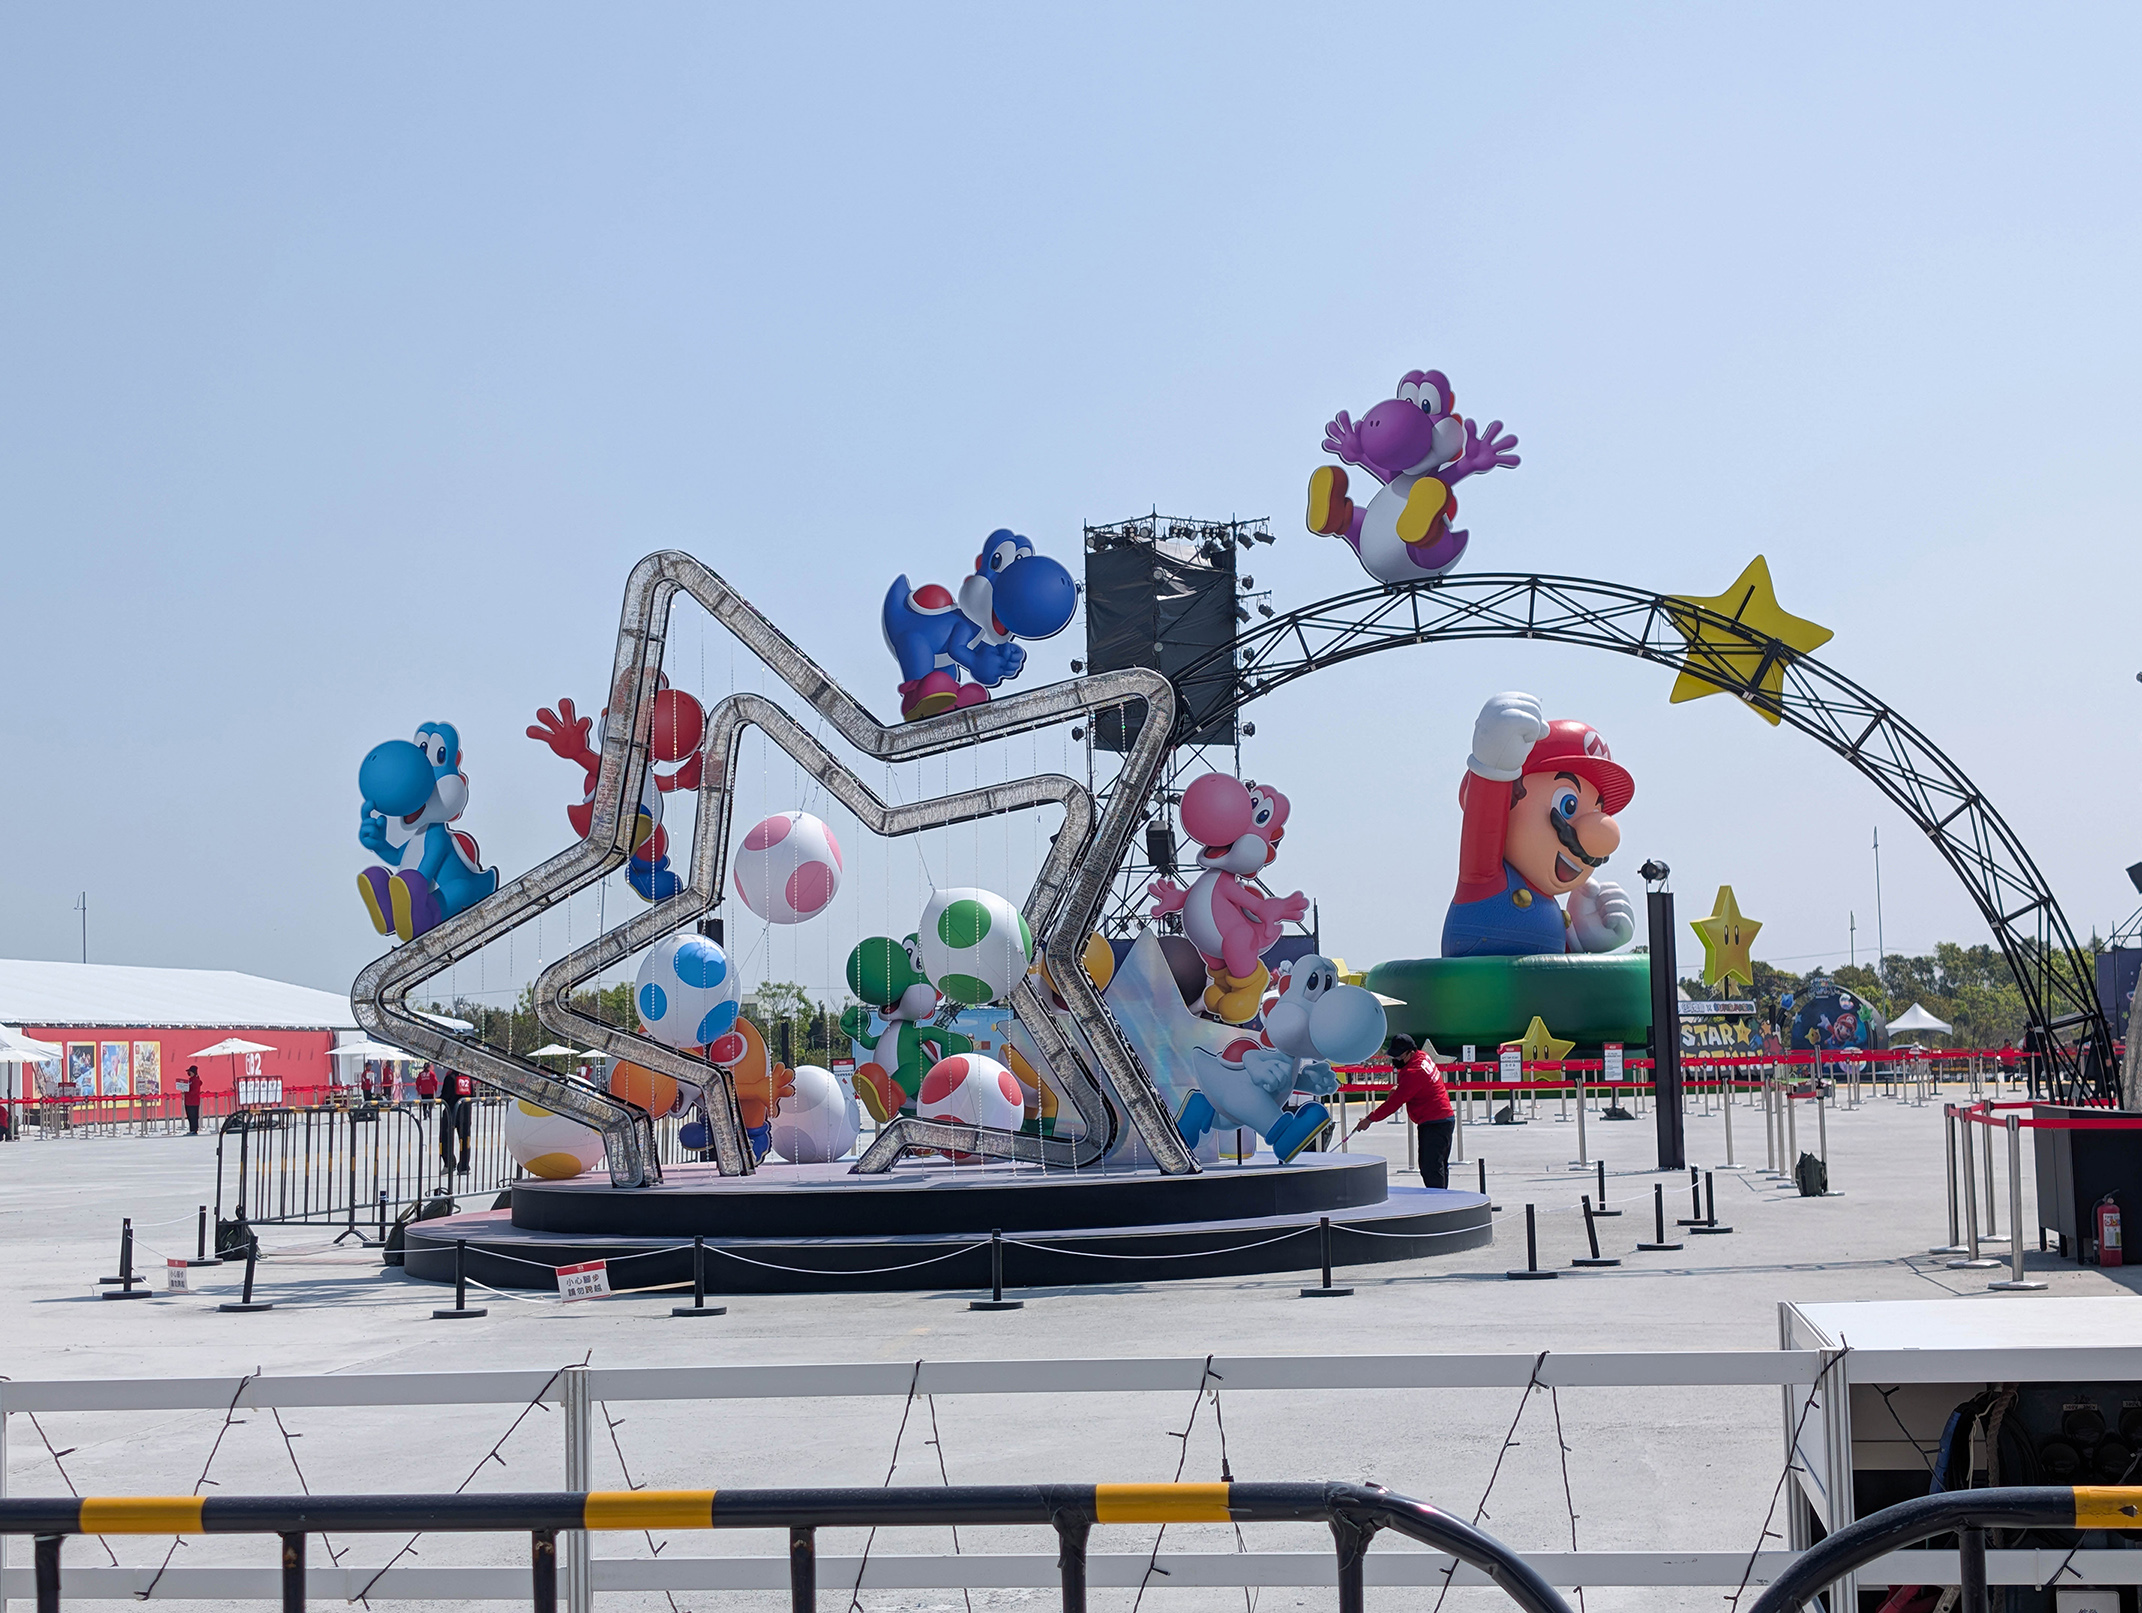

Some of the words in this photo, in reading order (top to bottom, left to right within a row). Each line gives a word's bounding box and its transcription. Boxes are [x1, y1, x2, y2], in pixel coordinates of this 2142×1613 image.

[1681, 1023, 1735, 1047] STAR
[567, 1273, 599, 1286] 小心腳步
[569, 1284, 602, 1297] 請勿跨越
